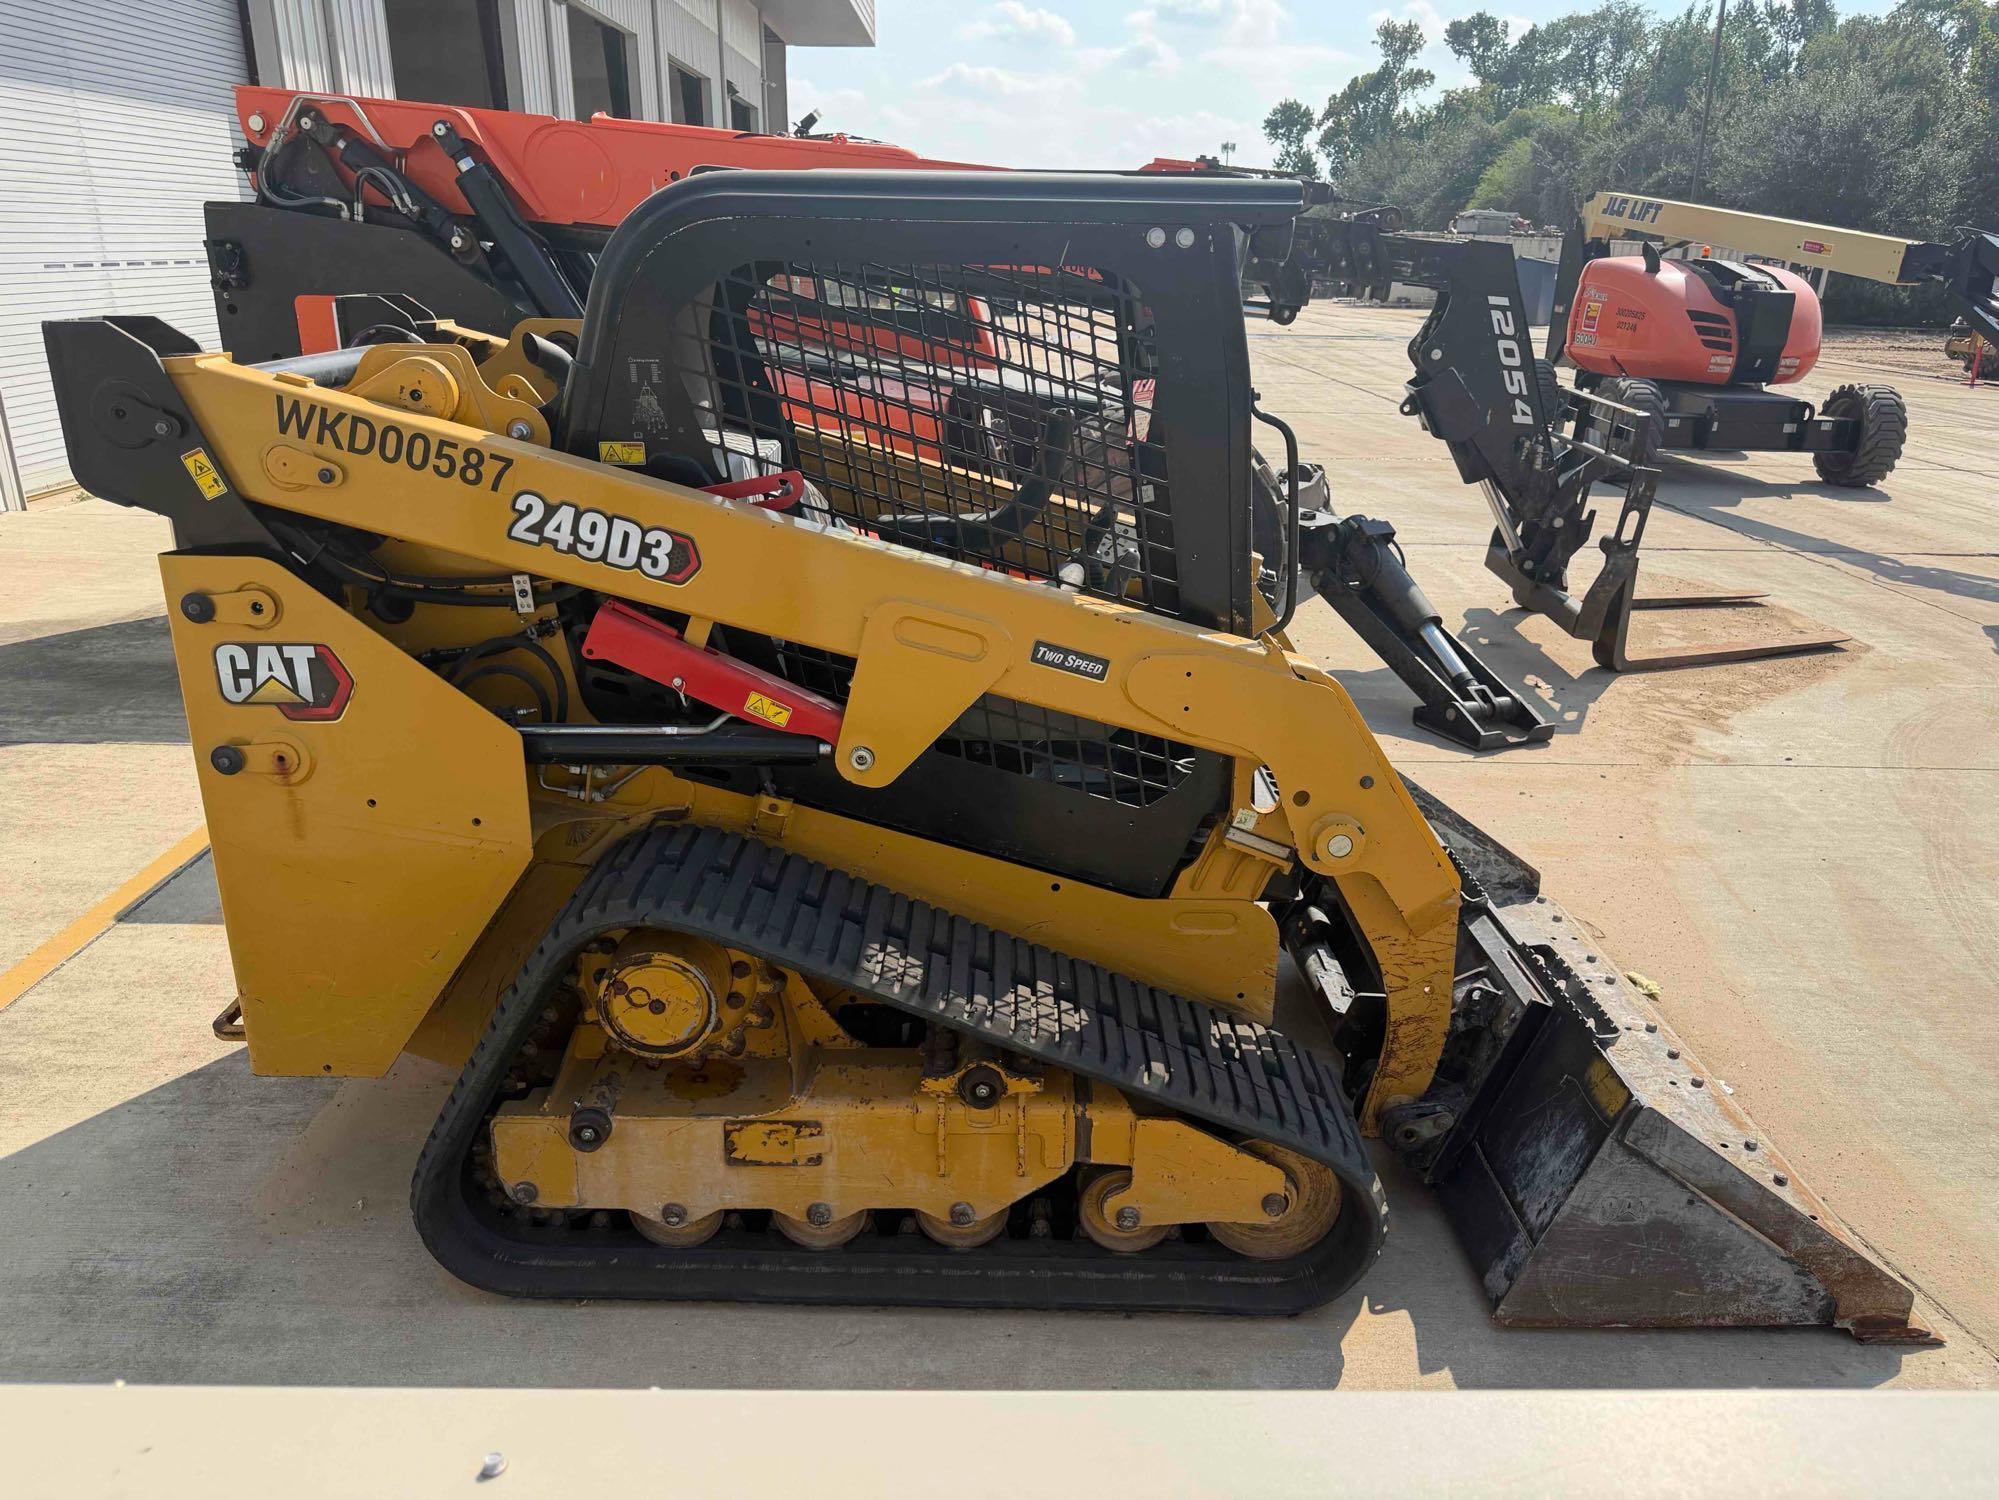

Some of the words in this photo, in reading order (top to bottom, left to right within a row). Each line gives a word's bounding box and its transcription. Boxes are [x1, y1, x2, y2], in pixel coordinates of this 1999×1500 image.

[1602, 197, 1629, 217] JLG
[1628, 201, 1663, 223] LIFT
[1487, 296, 1533, 424] 12054
[276, 395, 514, 492] WKD00587
[509, 494, 673, 577] 249D3
[216, 645, 316, 703] CAT
